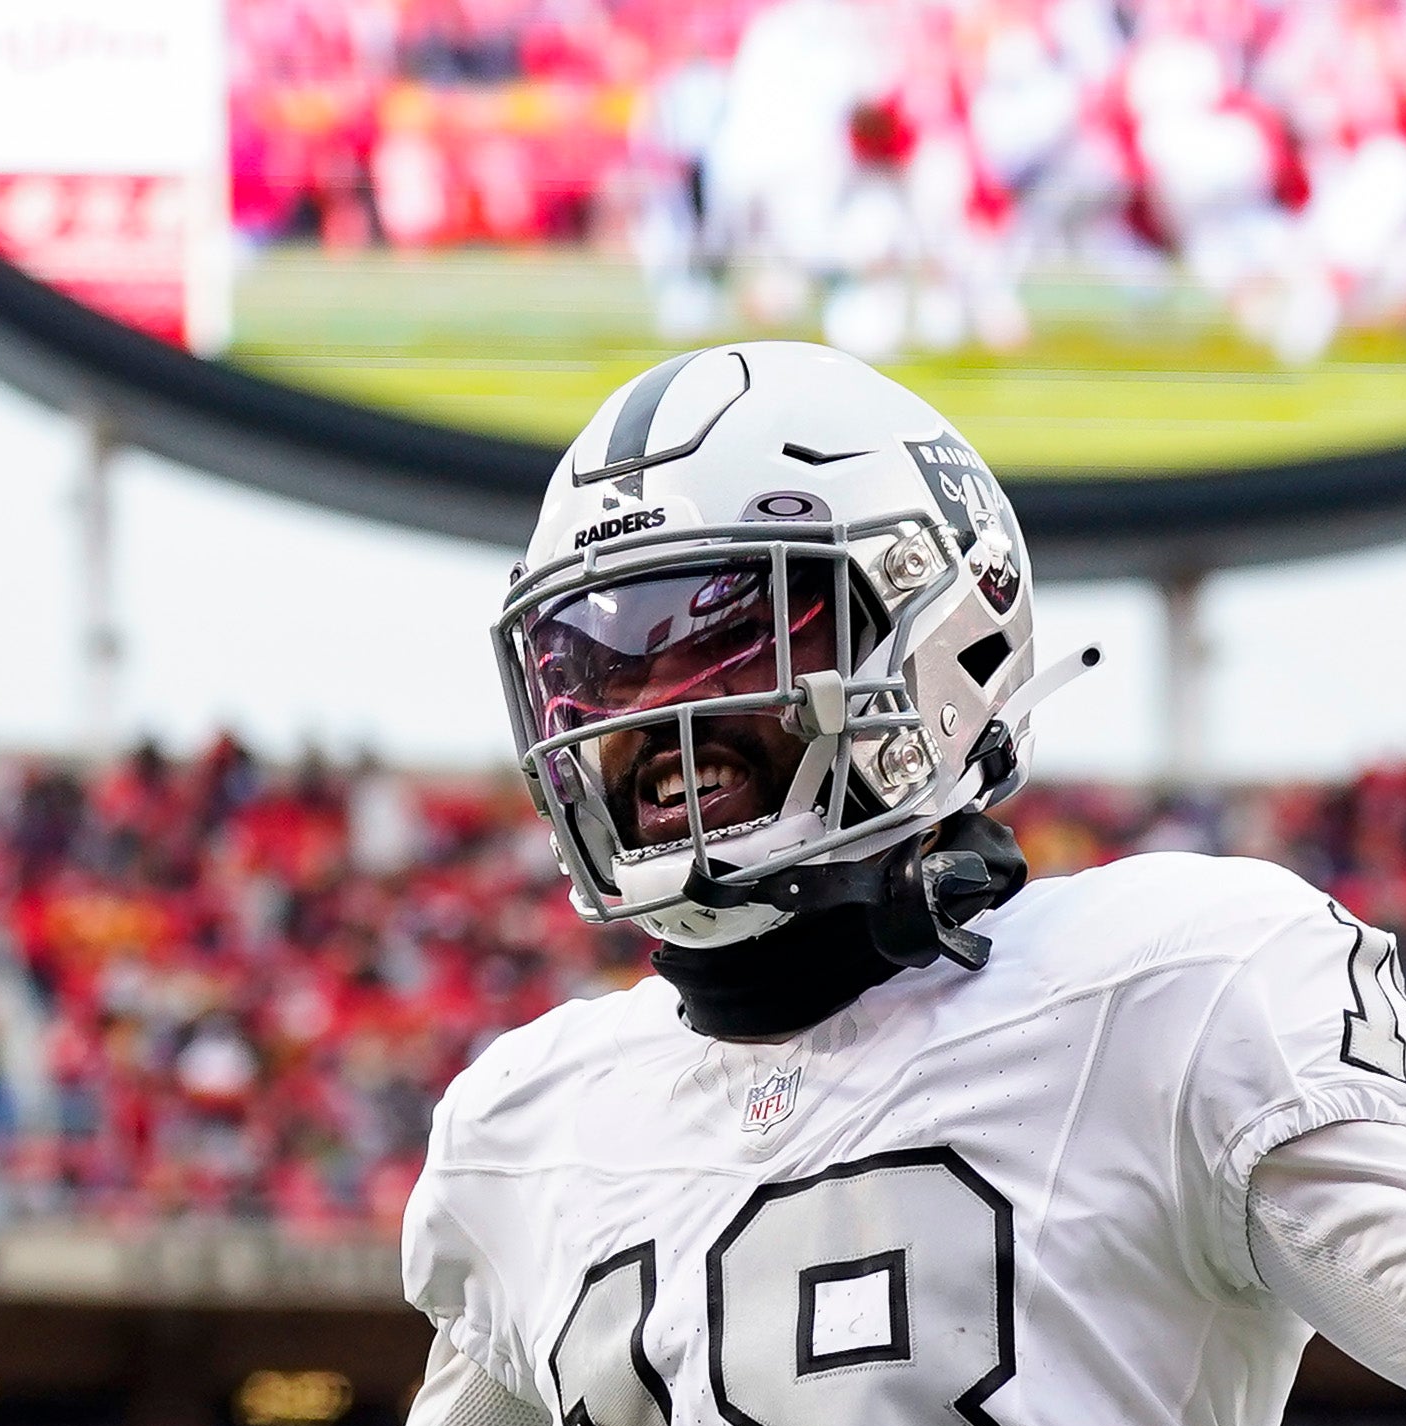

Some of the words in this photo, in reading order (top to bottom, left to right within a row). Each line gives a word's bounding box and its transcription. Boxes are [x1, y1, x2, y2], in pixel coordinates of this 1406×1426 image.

[917, 444, 987, 471] RAIDE
[574, 507, 666, 550] RAIDERS
[749, 1093, 785, 1121] NFL
